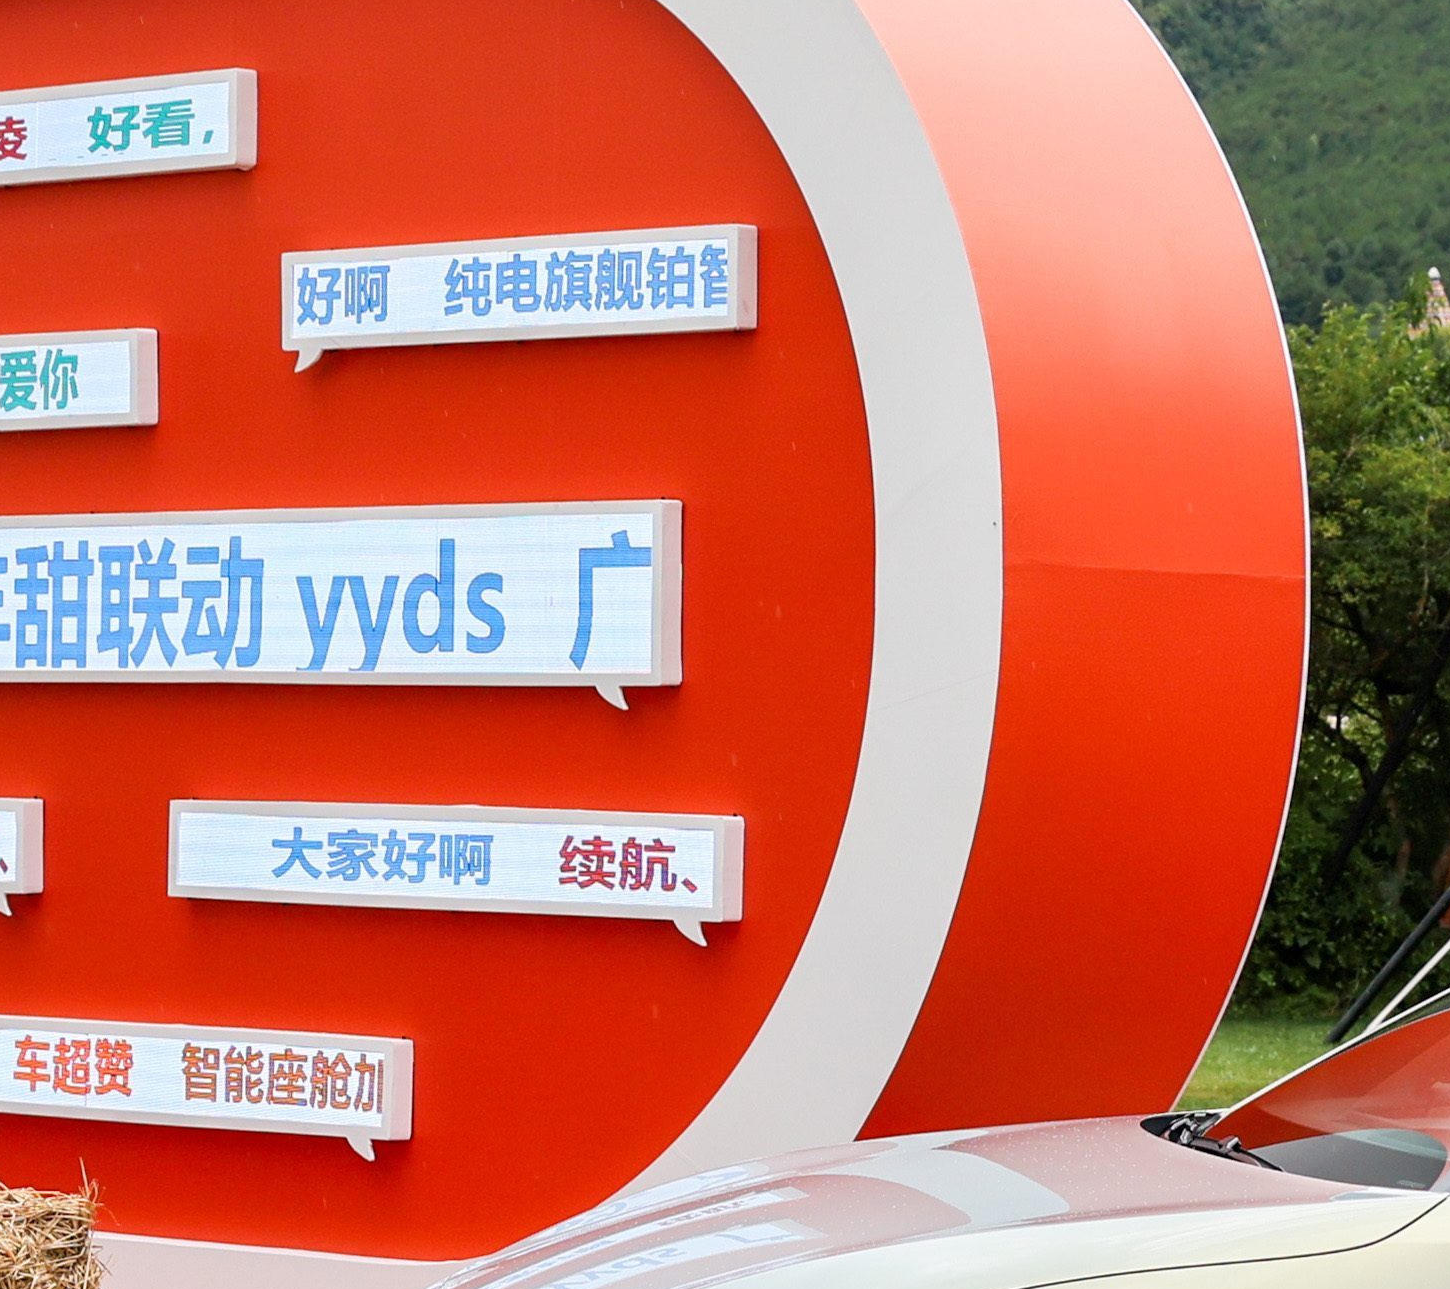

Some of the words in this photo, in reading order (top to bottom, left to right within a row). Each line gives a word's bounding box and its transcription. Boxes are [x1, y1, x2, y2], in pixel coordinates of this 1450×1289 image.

[297, 264, 390, 325] 好啊
[295, 539, 507, 671] yyds
[270, 825, 495, 887] 大家好啊
[557, 834, 699, 894] 续航、
